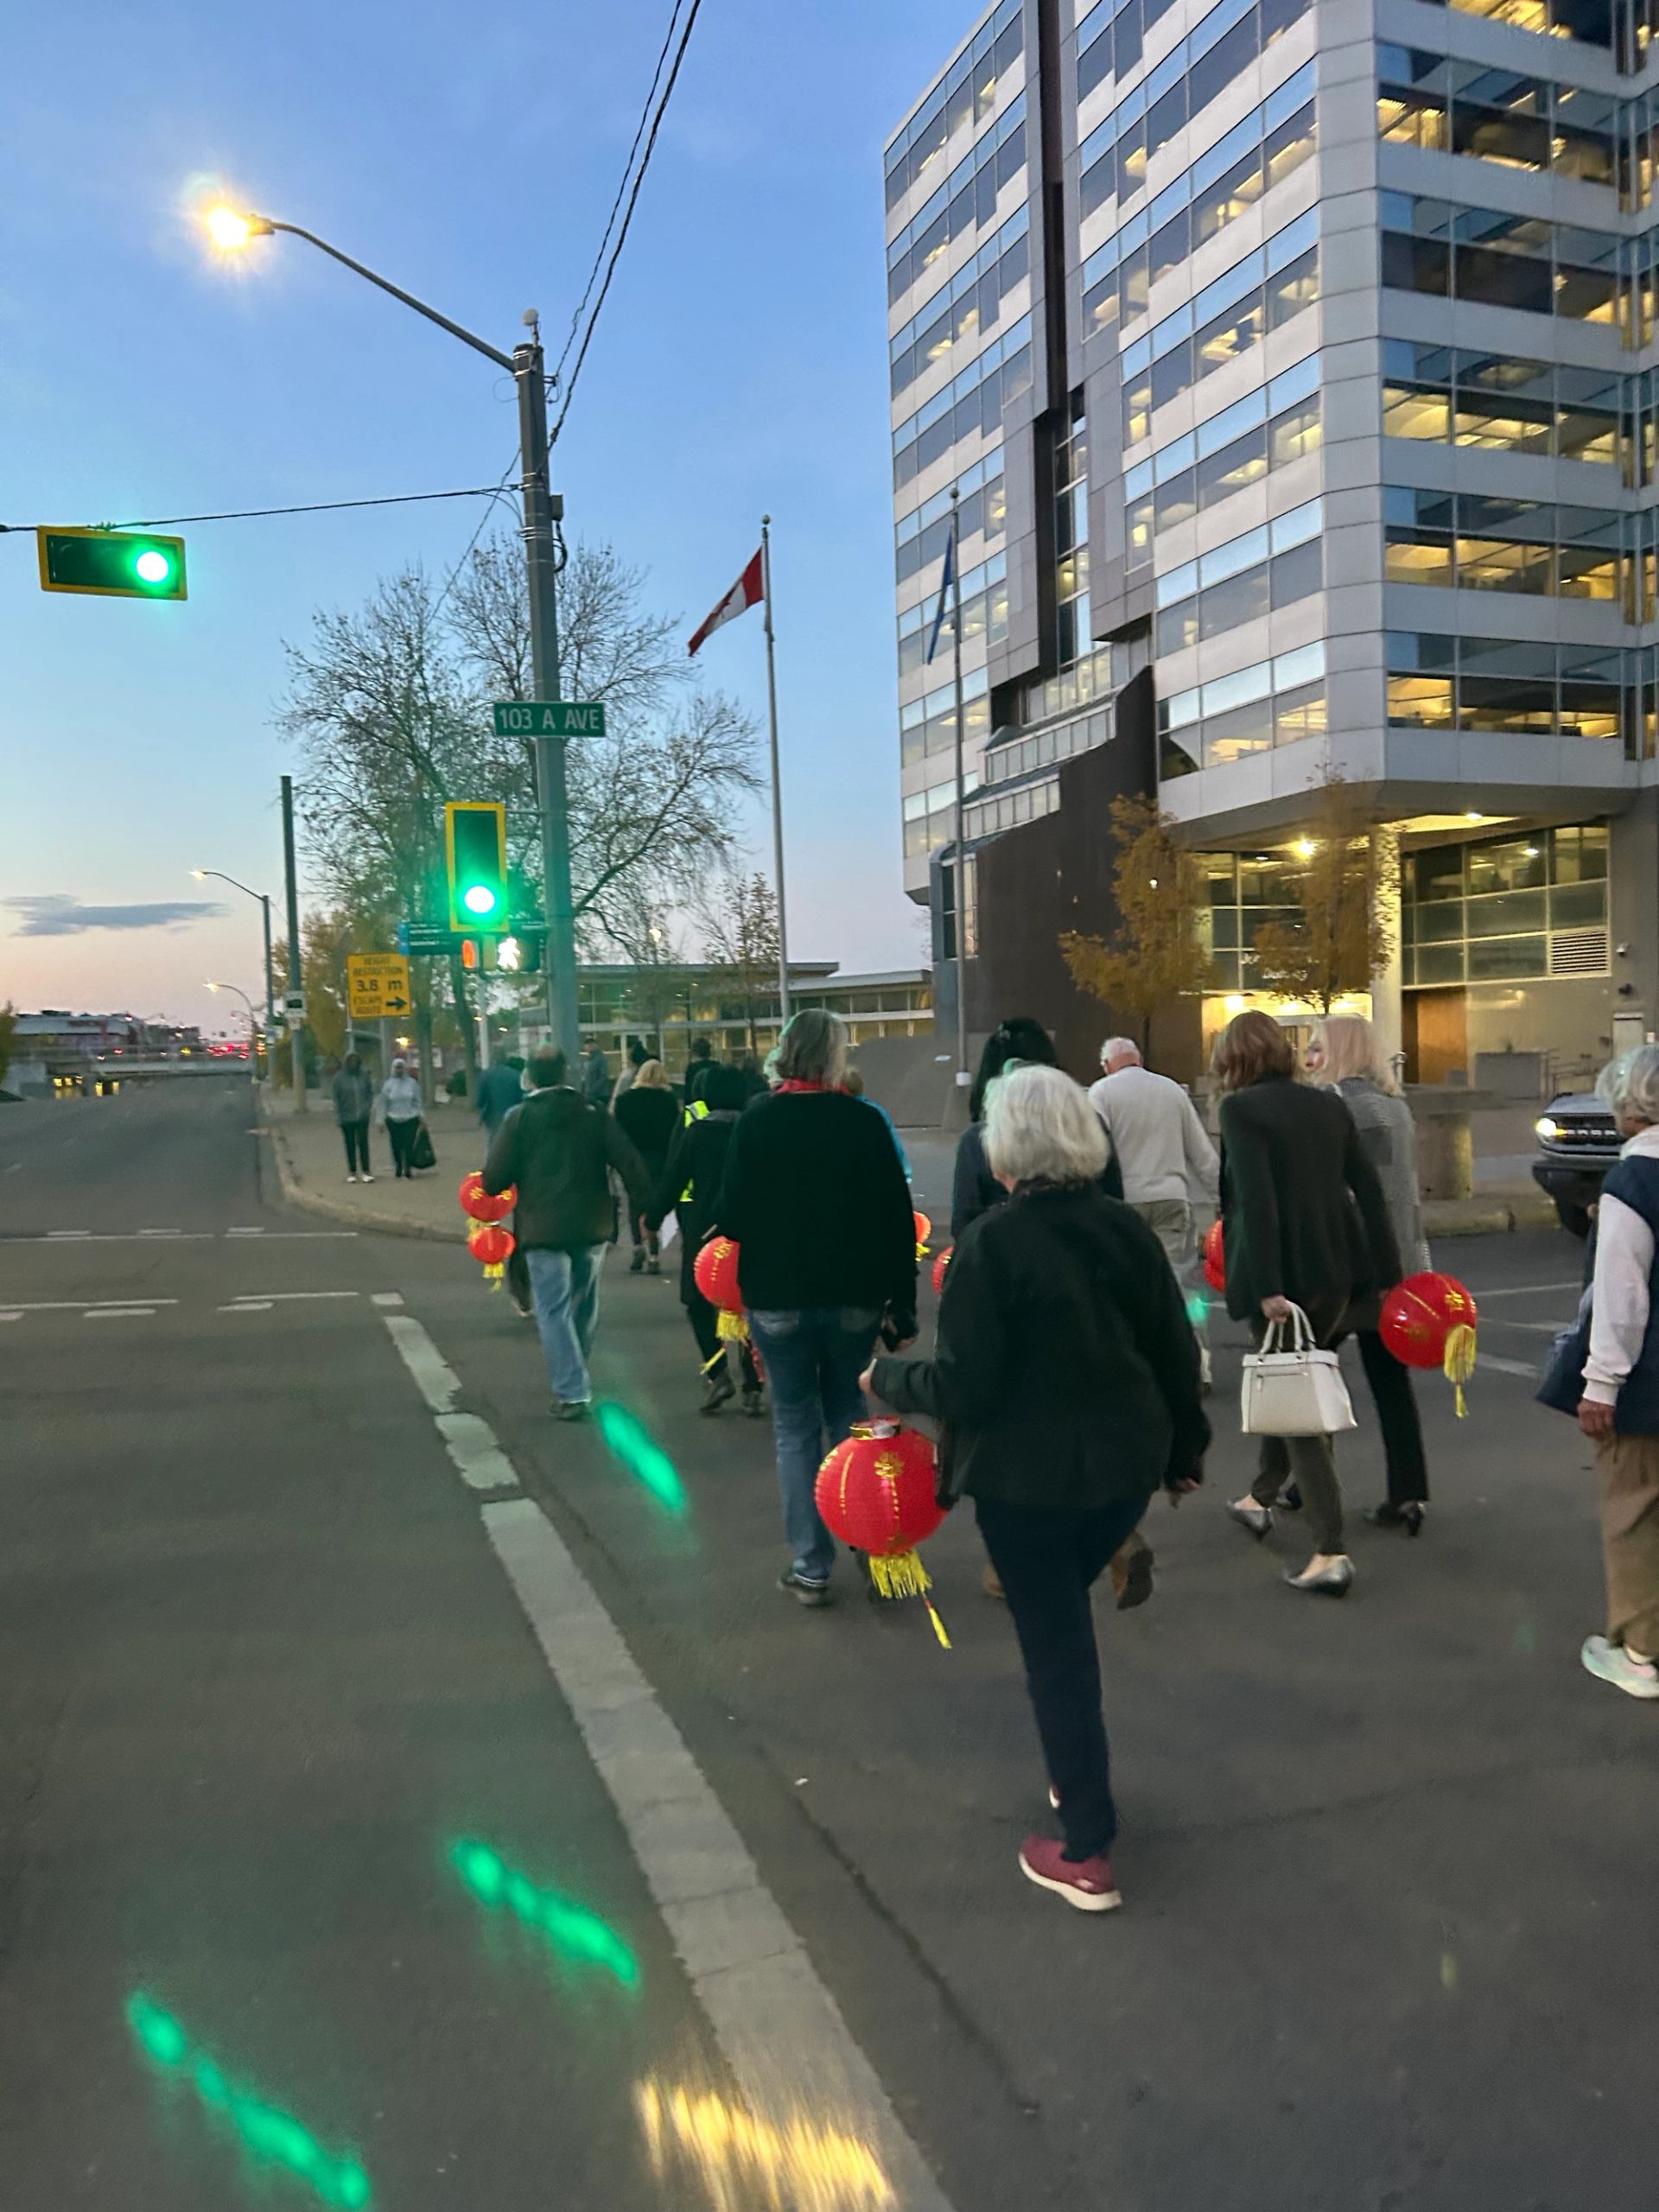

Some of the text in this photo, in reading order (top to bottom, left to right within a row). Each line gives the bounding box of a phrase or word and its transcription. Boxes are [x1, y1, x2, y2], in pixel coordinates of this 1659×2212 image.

[499, 709, 600, 729] 103 A AVE
[353, 967, 403, 976] RESTRICTION
[388, 980, 403, 991] m
